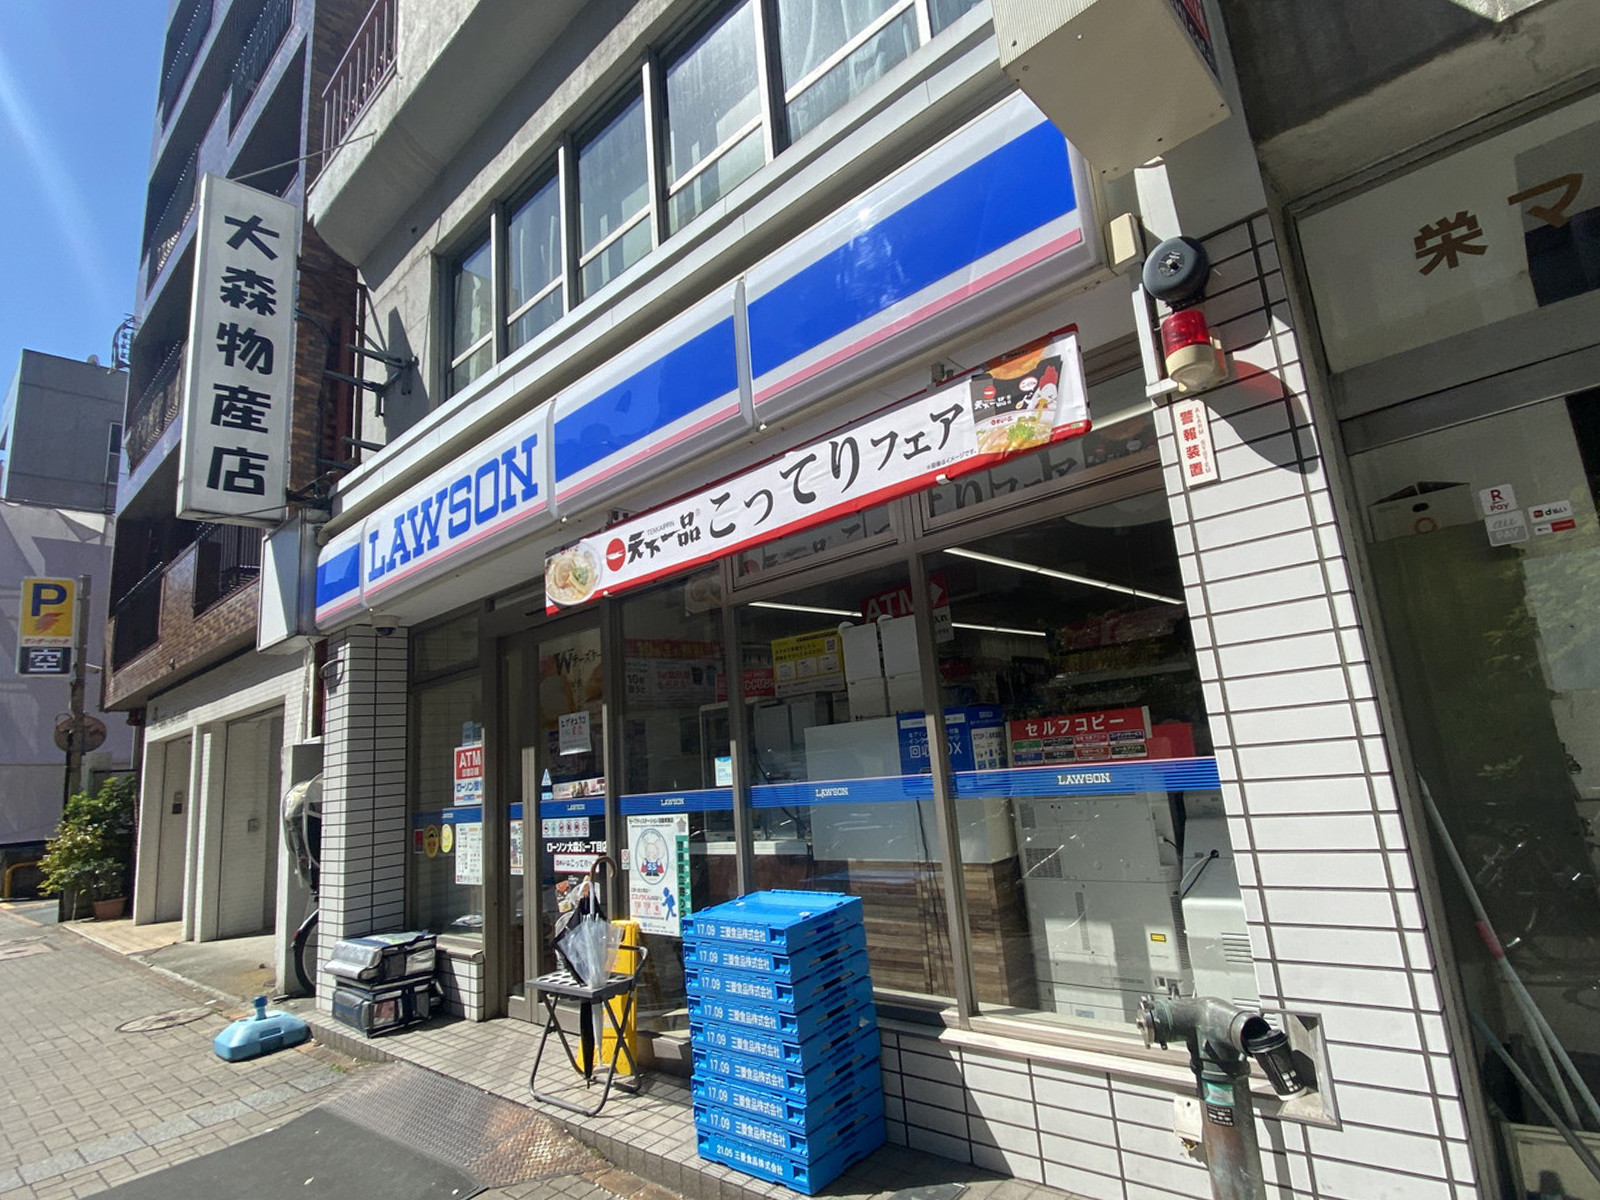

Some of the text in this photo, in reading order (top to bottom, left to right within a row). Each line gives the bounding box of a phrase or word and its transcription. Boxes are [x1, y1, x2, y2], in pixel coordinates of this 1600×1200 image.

[206, 214, 280, 496] 大森物産店
[1179, 409, 1204, 477] 警報装置
[709, 402, 964, 539] こってりフェア
[368, 433, 538, 582] LAWSON
[627, 510, 701, 564] 天下一品
[31, 583, 67, 617] P
[28, 649, 61, 672] 空
[1025, 714, 1125, 737] セルフコピー
[459, 751, 481, 769] ATM
[1057, 773, 1111, 785] LAWSON
[815, 787, 849, 797] LAWSON
[697, 923, 716, 936] 17.09
[699, 950, 718, 964] 17.09
[701, 976, 721, 990] 17.09
[704, 1004, 724, 1019] 17.09
[706, 1031, 727, 1046] 17.09
[709, 1059, 730, 1074] 17.09
[707, 1087, 728, 1102] 17.09
[710, 1114, 731, 1130] 17.09
